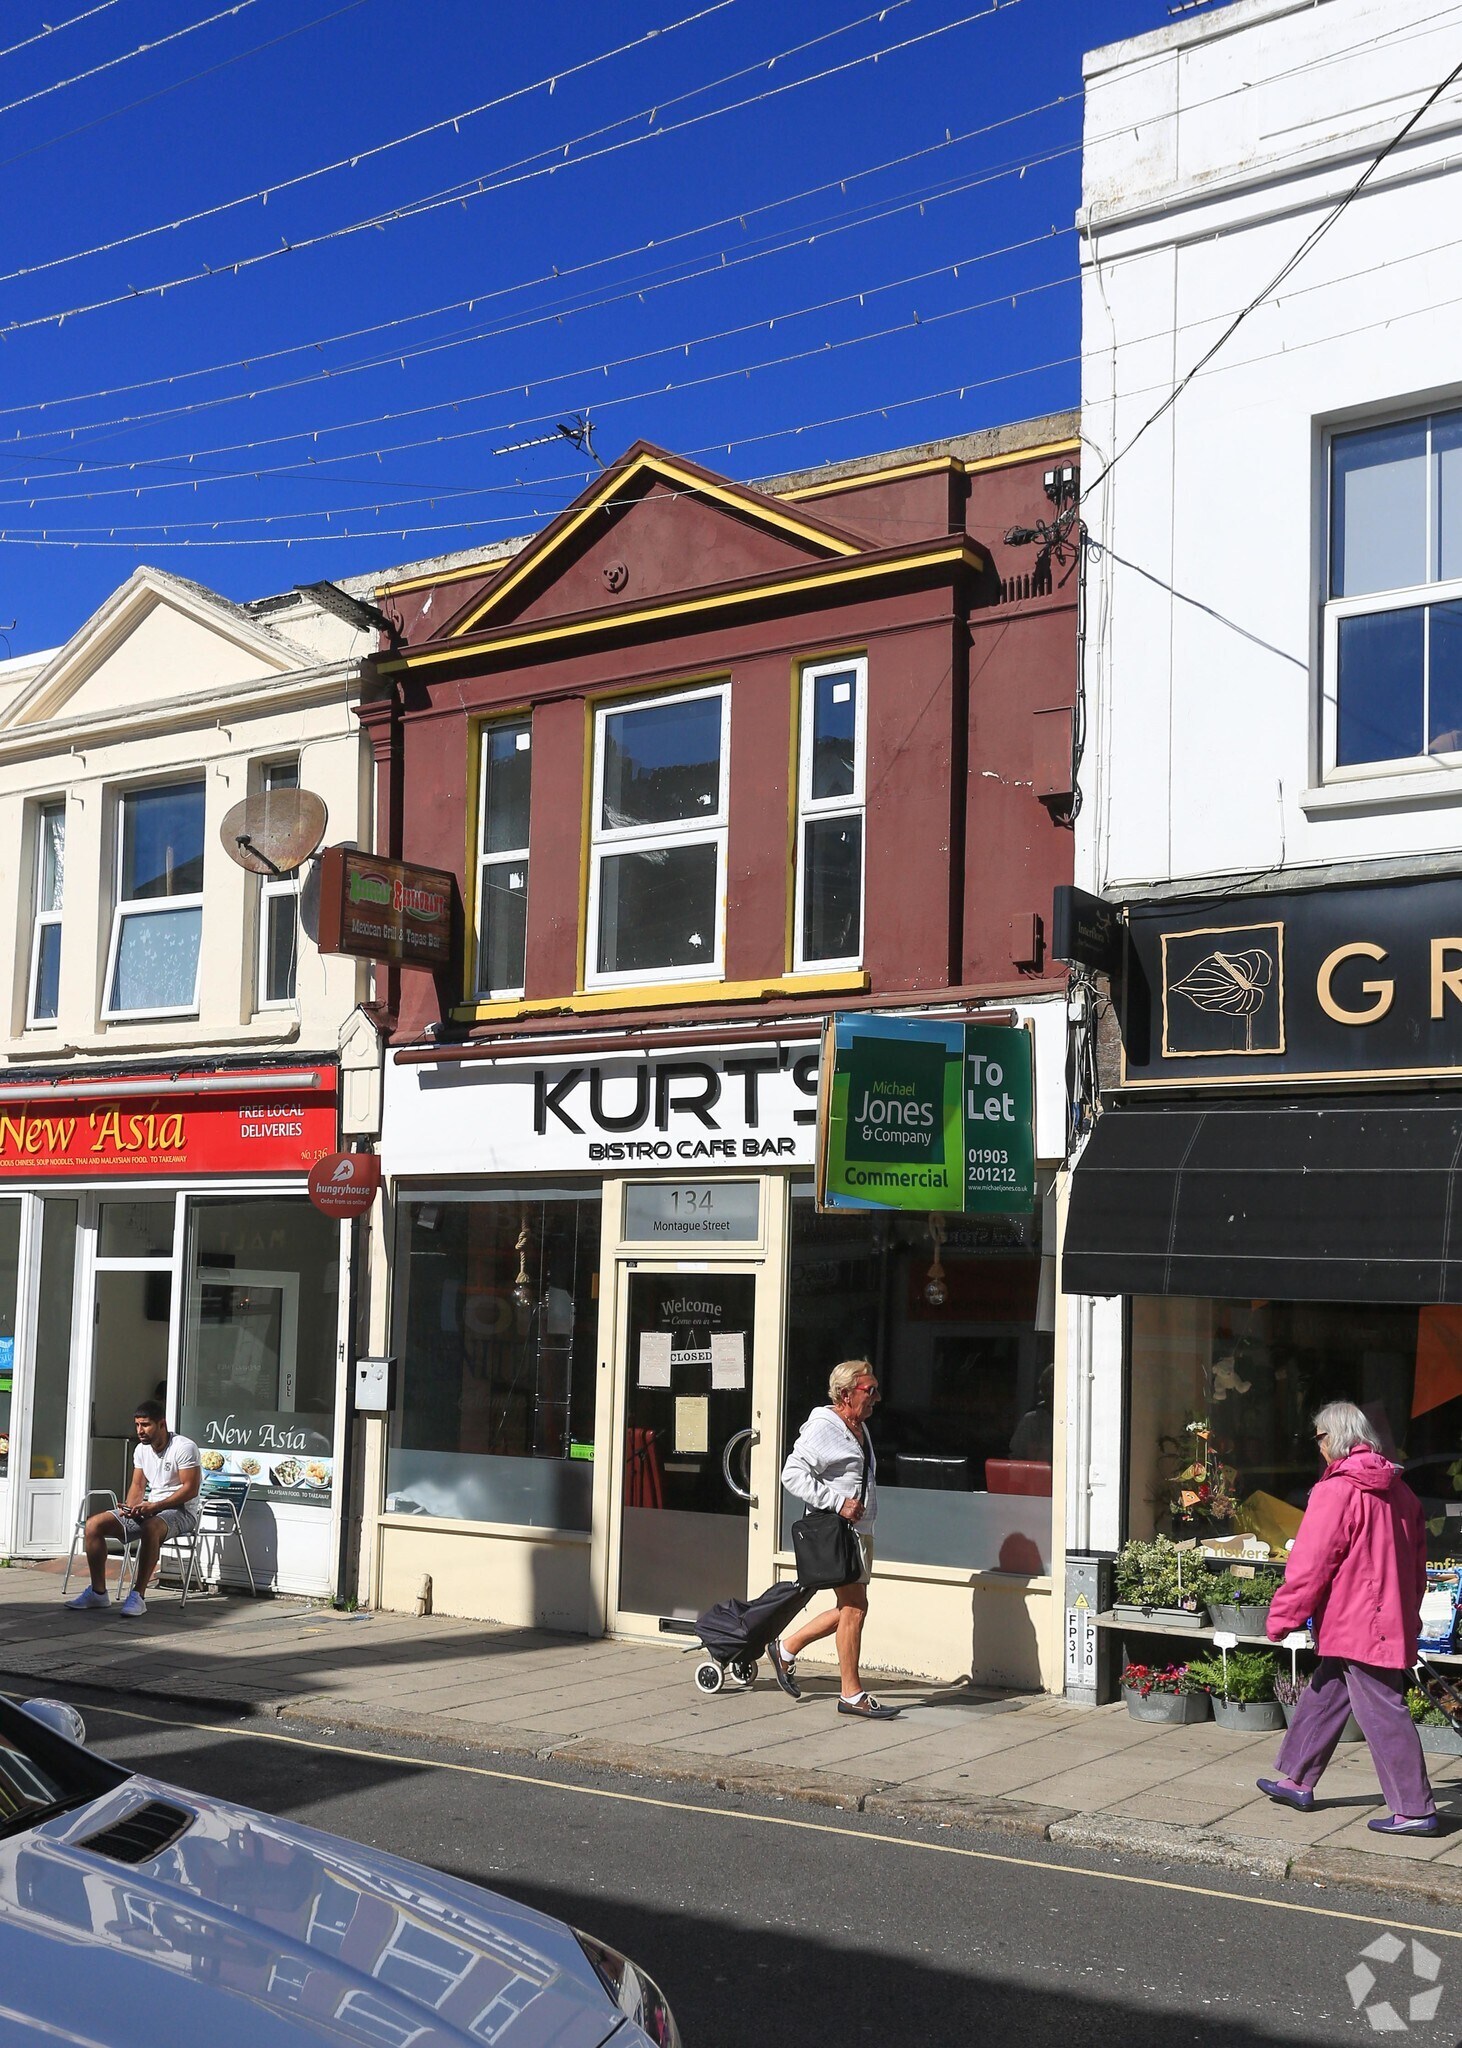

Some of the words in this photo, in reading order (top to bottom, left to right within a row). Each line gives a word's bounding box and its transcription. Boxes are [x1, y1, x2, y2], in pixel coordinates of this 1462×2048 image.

[352, 920, 382, 937] Mexican
[383, 924, 397, 941] Grill
[406, 929, 427, 948] Tapas
[428, 933, 441, 948] Bar
[968, 1054, 1003, 1087] To
[872, 1081, 916, 1097] Michael
[239, 1105, 265, 1119] FREE
[267, 1103, 304, 1117] LOCAL
[855, 1091, 934, 1126] Jones
[968, 1090, 1015, 1122] Let
[0, 1101, 77, 1154] New
[241, 1123, 302, 1138] DELIVERIES
[874, 1128, 931, 1146] Company
[313, 1148, 328, 1161] 136
[589, 1142, 673, 1160] BISTRO
[677, 1139, 736, 1158] CAFE
[742, 1137, 796, 1156] BAR
[968, 1149, 1008, 1164] 01903
[36, 1158, 49, 1166] SOUP
[76, 1157, 88, 1165] THAI
[89, 1157, 100, 1165] AND
[101, 1156, 130, 1165] MALAYSIAN
[150, 1156, 157, 1164] TO
[158, 1155, 187, 1164] TAKEAWAY
[844, 1167, 948, 1188] Commercial
[968, 1166, 1016, 1182] 201212
[316, 1182, 370, 1196] hungryhouse
[968, 1184, 1028, 1193] www.michaeljones.co.uk
[671, 1189, 714, 1216] 134
[653, 1219, 701, 1234] Montague
[702, 1219, 730, 1232] Street
[661, 1297, 723, 1316] Welcome
[671, 1315, 691, 1325] Come
[670, 1352, 712, 1362] CLOSED
[206, 1414, 252, 1445] New
[1214, 1543, 1269, 1560] flowers
[1069, 1614, 1077, 1663] FP31
